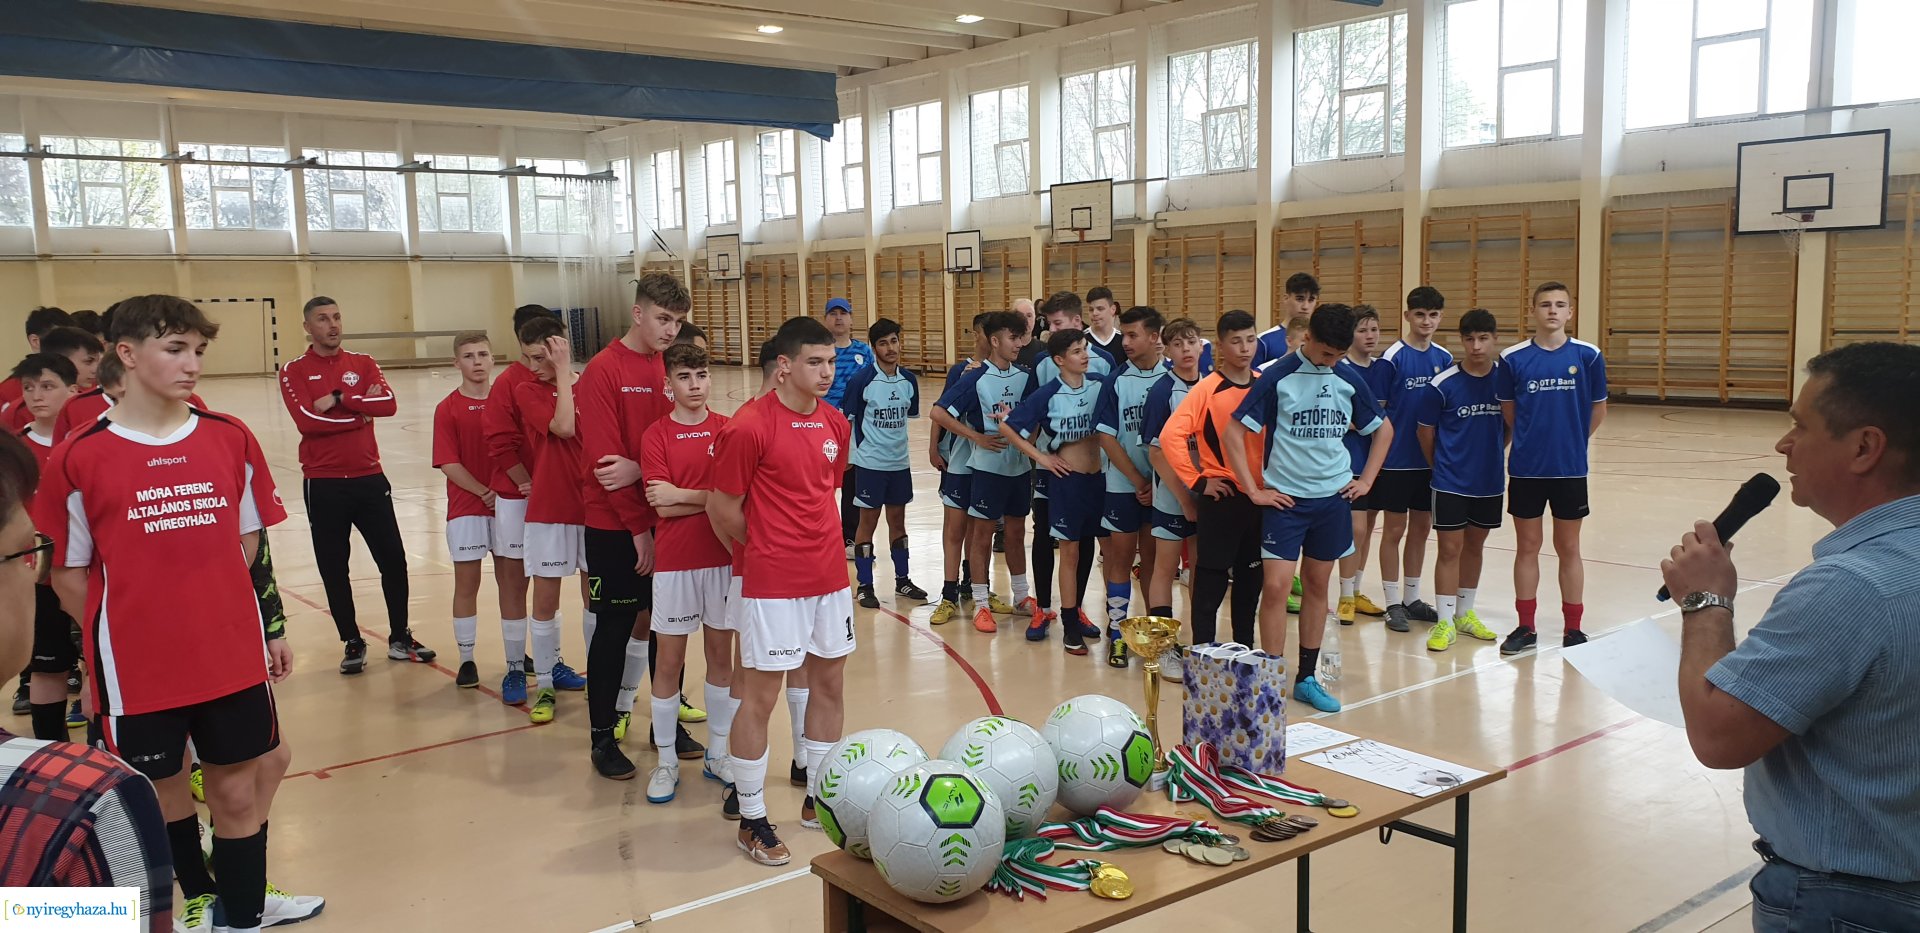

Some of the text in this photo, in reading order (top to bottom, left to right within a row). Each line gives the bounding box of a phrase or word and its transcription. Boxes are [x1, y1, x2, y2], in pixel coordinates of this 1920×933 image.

[1540, 379, 1557, 387] OTP
[621, 386, 653, 394] GIVOVA
[1292, 404, 1348, 426] PETŐFI DSE
[791, 421, 824, 429] GIVOVA
[676, 431, 711, 440] GIVOVA
[146, 455, 188, 468] uhlsport
[136, 481, 214, 503] MÓRA FERENC
[127, 496, 228, 521] ÁLTALÁNOS ISKOLA
[143, 511, 217, 534] NYÍREGYHÁZA
[667, 613, 700, 623] GIVOVA
[768, 647, 802, 656] GIVOVA
